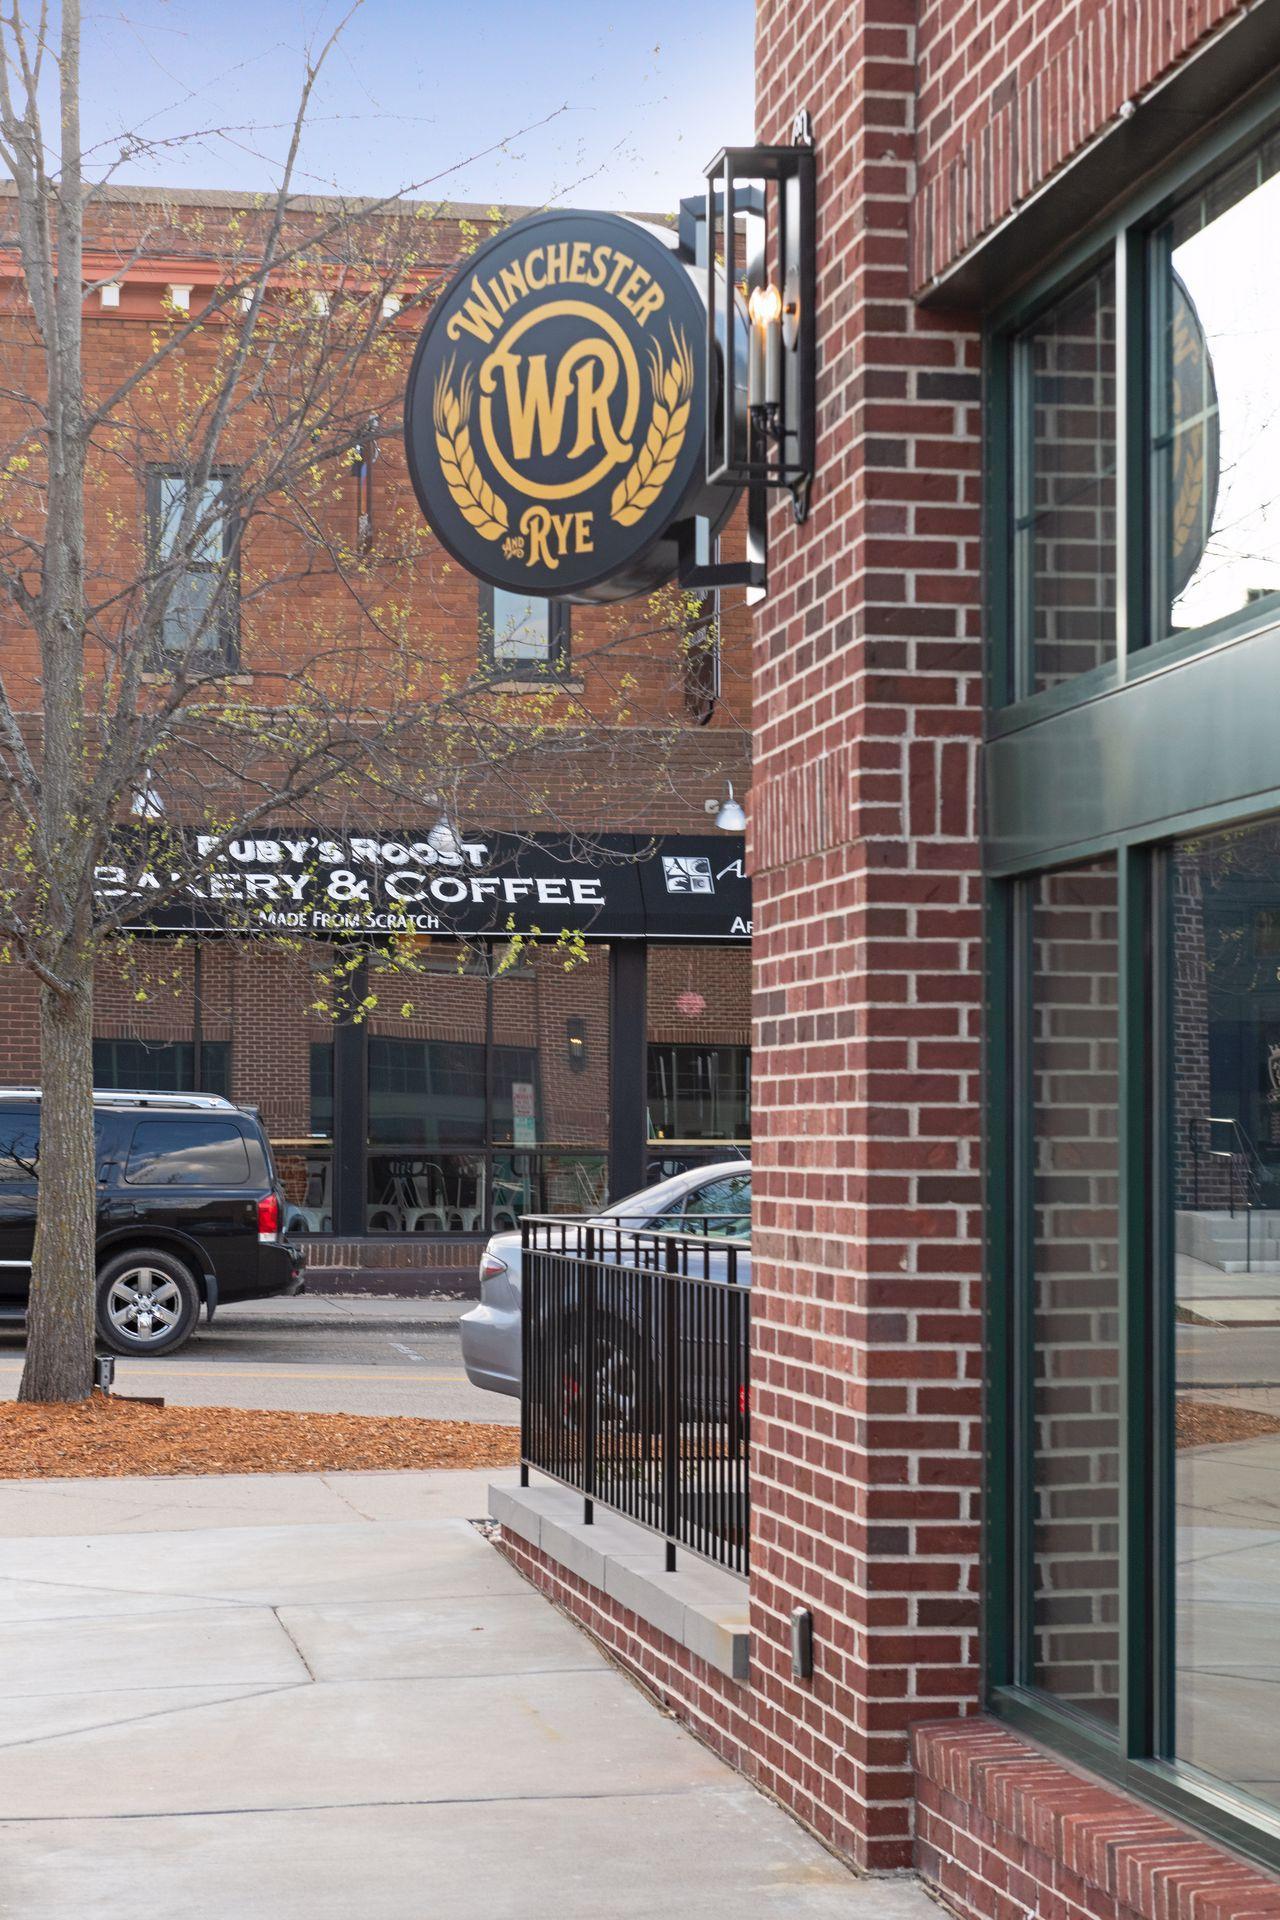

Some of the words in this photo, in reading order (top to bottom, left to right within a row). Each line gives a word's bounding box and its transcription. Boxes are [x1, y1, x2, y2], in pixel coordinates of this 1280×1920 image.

[447, 241, 665, 345] WINCHESTER
[480, 338, 633, 463] WR
[520, 505, 594, 570] RYE
[326, 869, 370, 901] &
[384, 871, 605, 905] COFFEE
